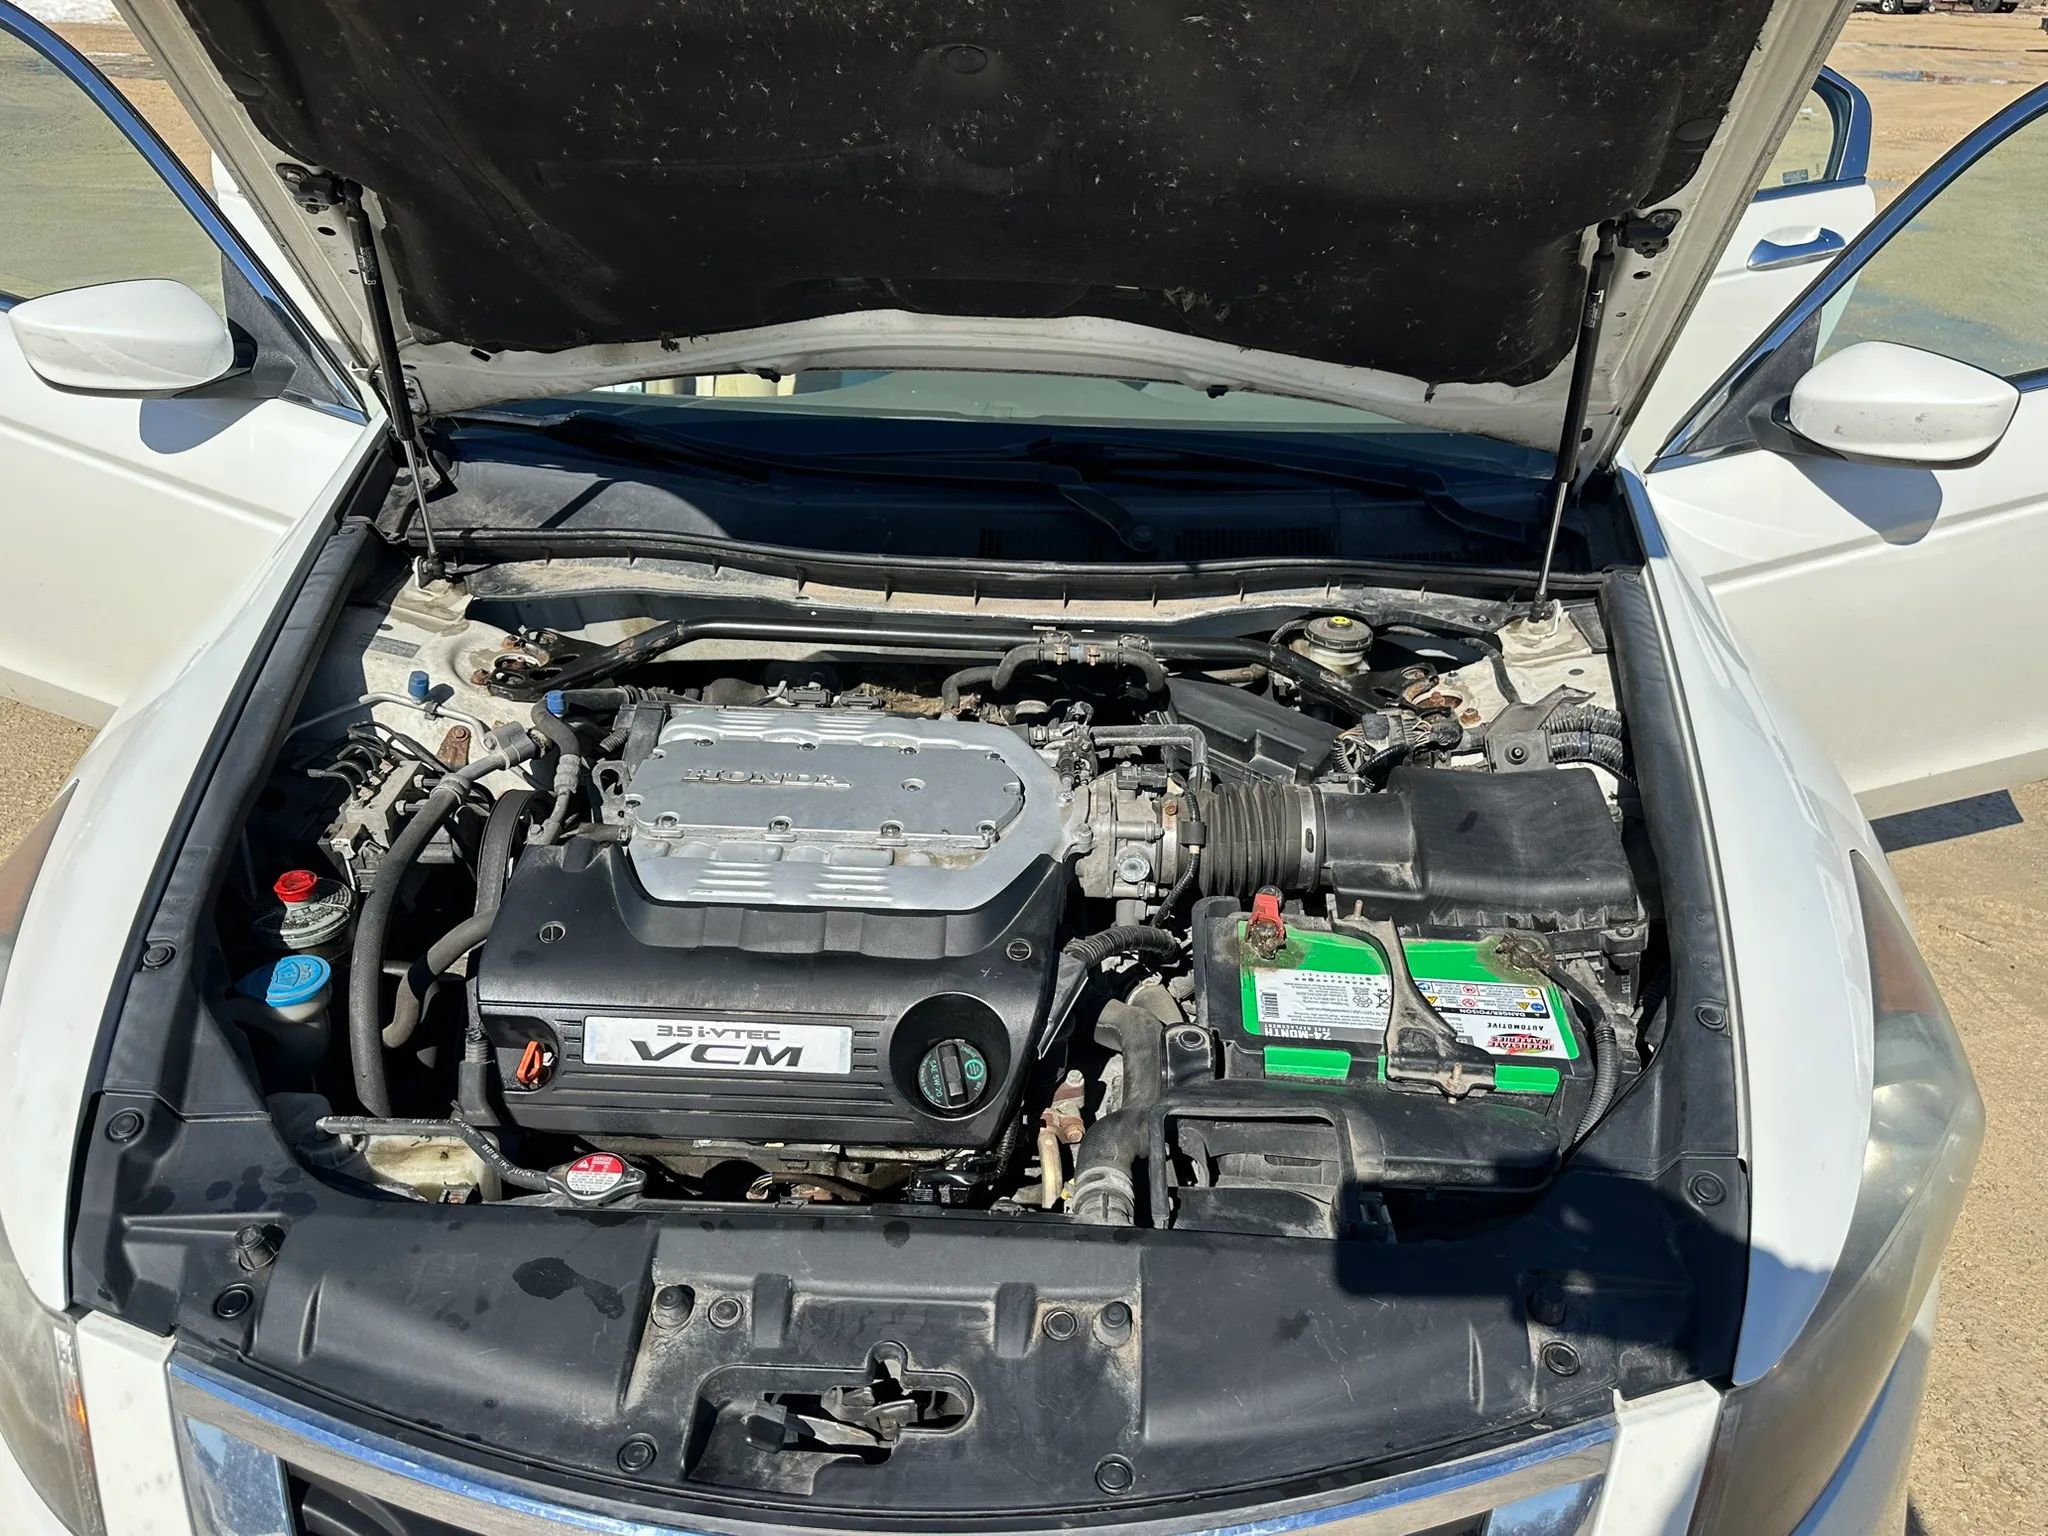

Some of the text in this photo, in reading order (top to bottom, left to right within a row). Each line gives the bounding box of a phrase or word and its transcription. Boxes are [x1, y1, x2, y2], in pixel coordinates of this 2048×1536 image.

[681, 768, 852, 788] HONDA
[656, 1025, 781, 1041] 3.5 i-VTEC
[1263, 1023, 1311, 1031] REPLACEMENT
[1487, 1022, 1544, 1031] AUTOMOTIVE
[1263, 1027, 1332, 1040] 24-MONTH
[1490, 1036, 1551, 1044] BATTERIES
[1486, 1041, 1555, 1051] INTERSTATE
[629, 1039, 804, 1067] VCM
[929, 1059, 939, 1073] SAE
